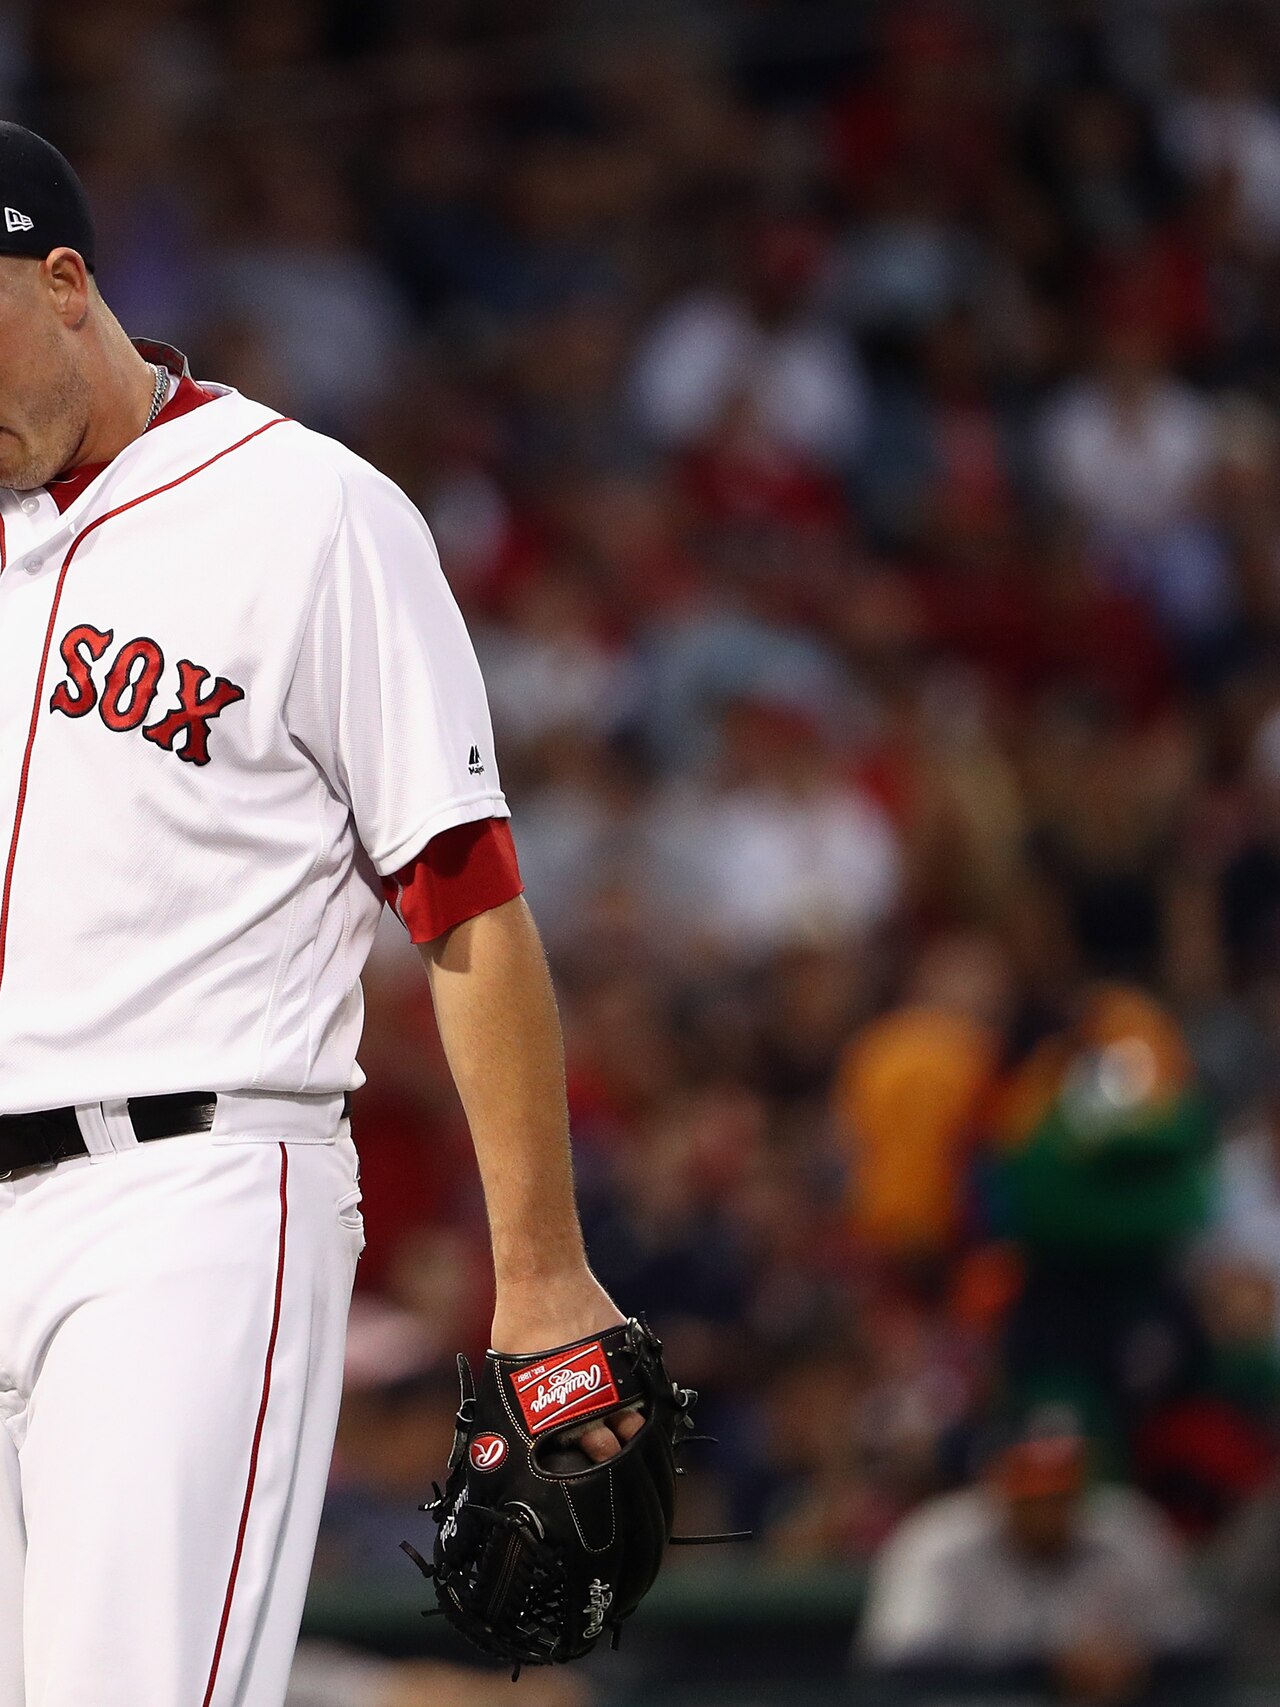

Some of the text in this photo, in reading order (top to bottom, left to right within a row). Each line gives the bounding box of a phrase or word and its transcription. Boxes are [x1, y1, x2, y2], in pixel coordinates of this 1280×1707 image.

[50, 624, 246, 766] SOX
[530, 1364, 601, 1413] Rawlings
[472, 1439, 505, 1468] R
